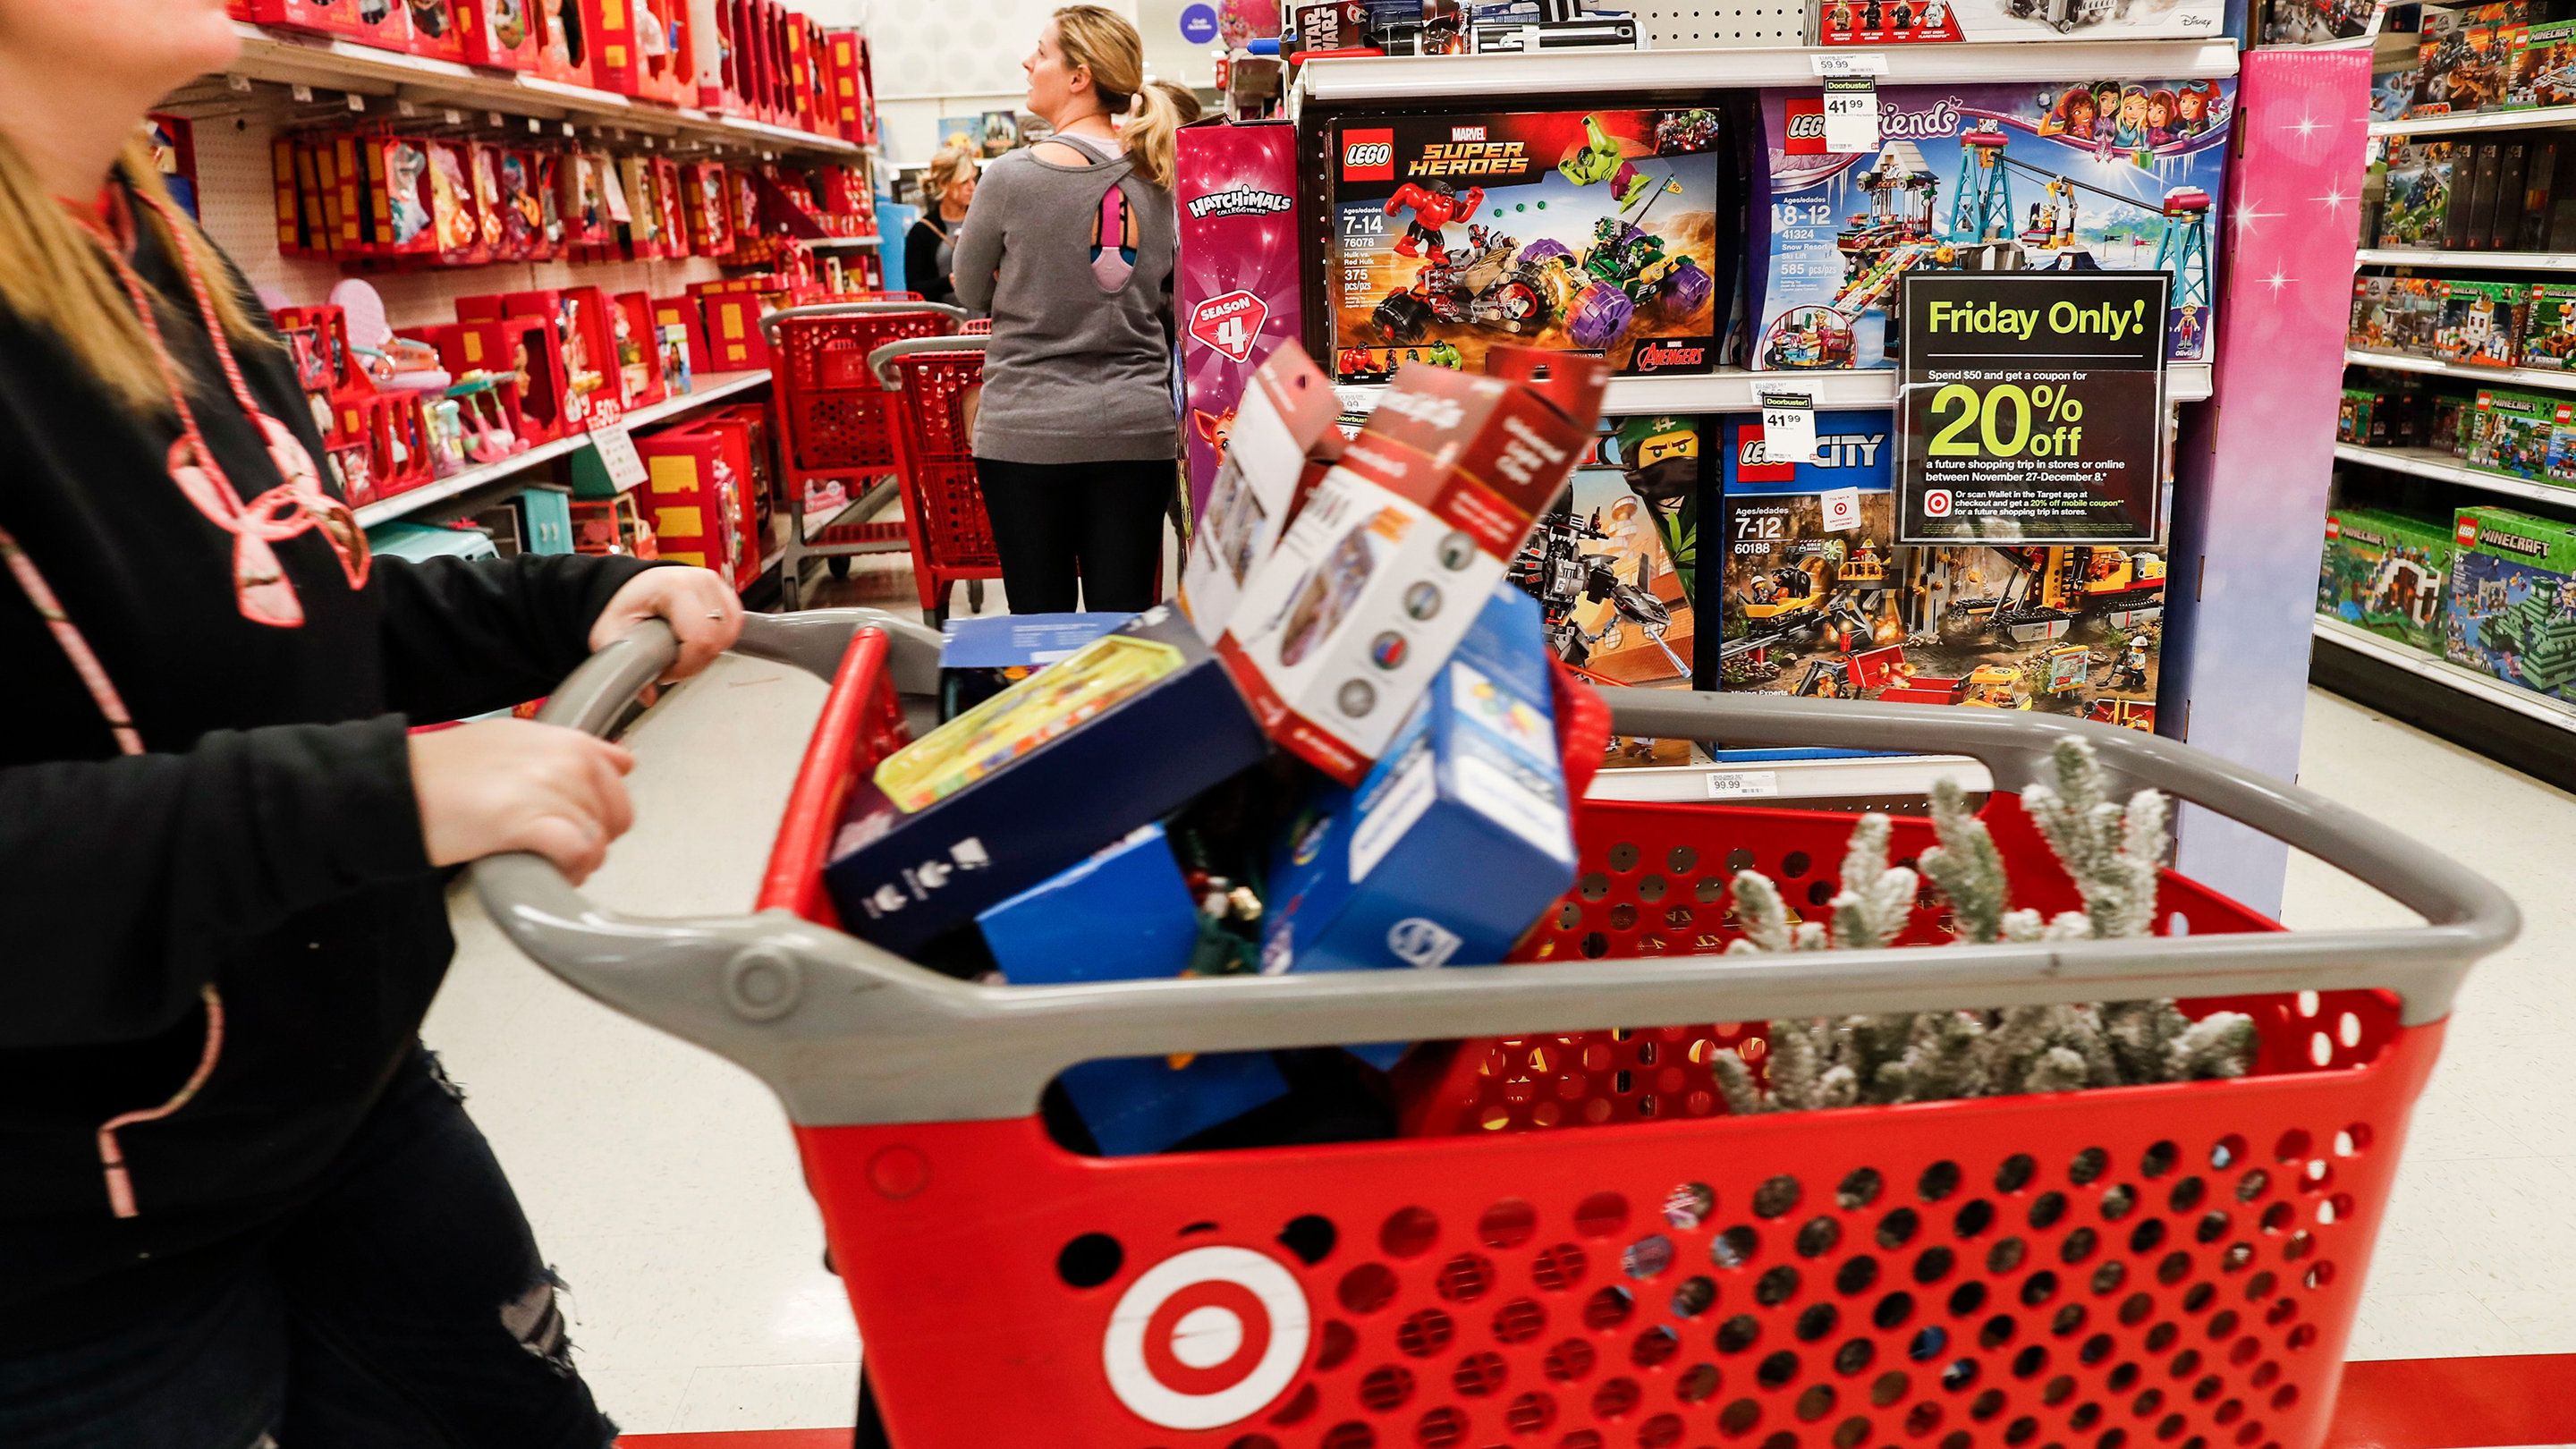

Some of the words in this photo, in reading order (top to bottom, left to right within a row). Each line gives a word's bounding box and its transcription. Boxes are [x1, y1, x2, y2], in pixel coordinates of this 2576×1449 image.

[2181, 14, 2212, 29] Disney
[2529, 27, 2576, 42] MINECRAFT
[1820, 61, 1849, 69] 59.99
[1828, 100, 1847, 114] 41
[1789, 114, 1826, 138] LEG
[1453, 127, 1487, 141] MARVEL
[1345, 143, 1392, 166] LEGO
[1422, 141, 1525, 159] SUPER
[1408, 157, 1530, 176] HEROES
[1673, 183, 1680, 191] 90
[1784, 197, 1826, 206] Ages/edades
[1783, 205, 1832, 225] 8-12
[1343, 215, 1384, 234] 7-14
[1782, 229, 1815, 240] 41324
[1343, 238, 1375, 248] 76078
[1344, 268, 1368, 281] 375
[1782, 263, 1805, 275] 585
[1809, 265, 1837, 277] pcs/pzs
[1345, 281, 1372, 293] pcs/pzs
[1200, 297, 1252, 322] SEASON
[1929, 301, 2039, 341] Friday
[2048, 299, 2145, 341] Only!
[1217, 316, 1245, 354] 4
[1637, 342, 1706, 372] AVENGERS
[1928, 370, 1962, 381] Spend
[1962, 370, 1982, 381] $50
[1984, 370, 2004, 380] and
[2005, 371, 2023, 382] get
[2024, 372, 2031, 381] a
[2032, 372, 2072, 383] coupon
[2072, 371, 2088, 381] for
[1766, 398, 1809, 406] Doorbuster!
[2492, 399, 2537, 413] MINECRAFT
[1767, 414, 1785, 427] 41
[2030, 426, 2082, 457] off
[1935, 460, 1966, 469] future
[1968, 460, 2014, 470] shopping
[2017, 460, 2034, 471] trip
[2036, 460, 2046, 469] in
[2048, 461, 2080, 469] stores
[2095, 460, 2125, 469] online
[1926, 472, 1970, 481] between
[1971, 472, 2023, 481] November
[2025, 472, 2092, 481] 27-December
[1955, 491, 1966, 499] Or
[1987, 491, 2012, 499] Wallet
[2013, 491, 2021, 499] in
[2038, 492, 2062, 500] Target
[2063, 493, 2078, 501] app
[1955, 499, 1992, 507] checkout
[1993, 499, 2009, 507] and
[2030, 499, 2047, 507] 20%
[2049, 499, 2061, 507] off
[2061, 499, 2088, 507] mobile
[1735, 507, 1789, 517] Ages/edades
[2000, 508, 2035, 517] shopping
[2037, 509, 2050, 517] trip
[1735, 517, 1782, 538] 7-12
[2458, 525, 2476, 538] LEGO
[1735, 542, 1771, 555] 60188
[2479, 528, 2551, 558] MINECRAFT
[2454, 552, 2465, 564] 8+
[1714, 780, 1741, 789] 99.99
